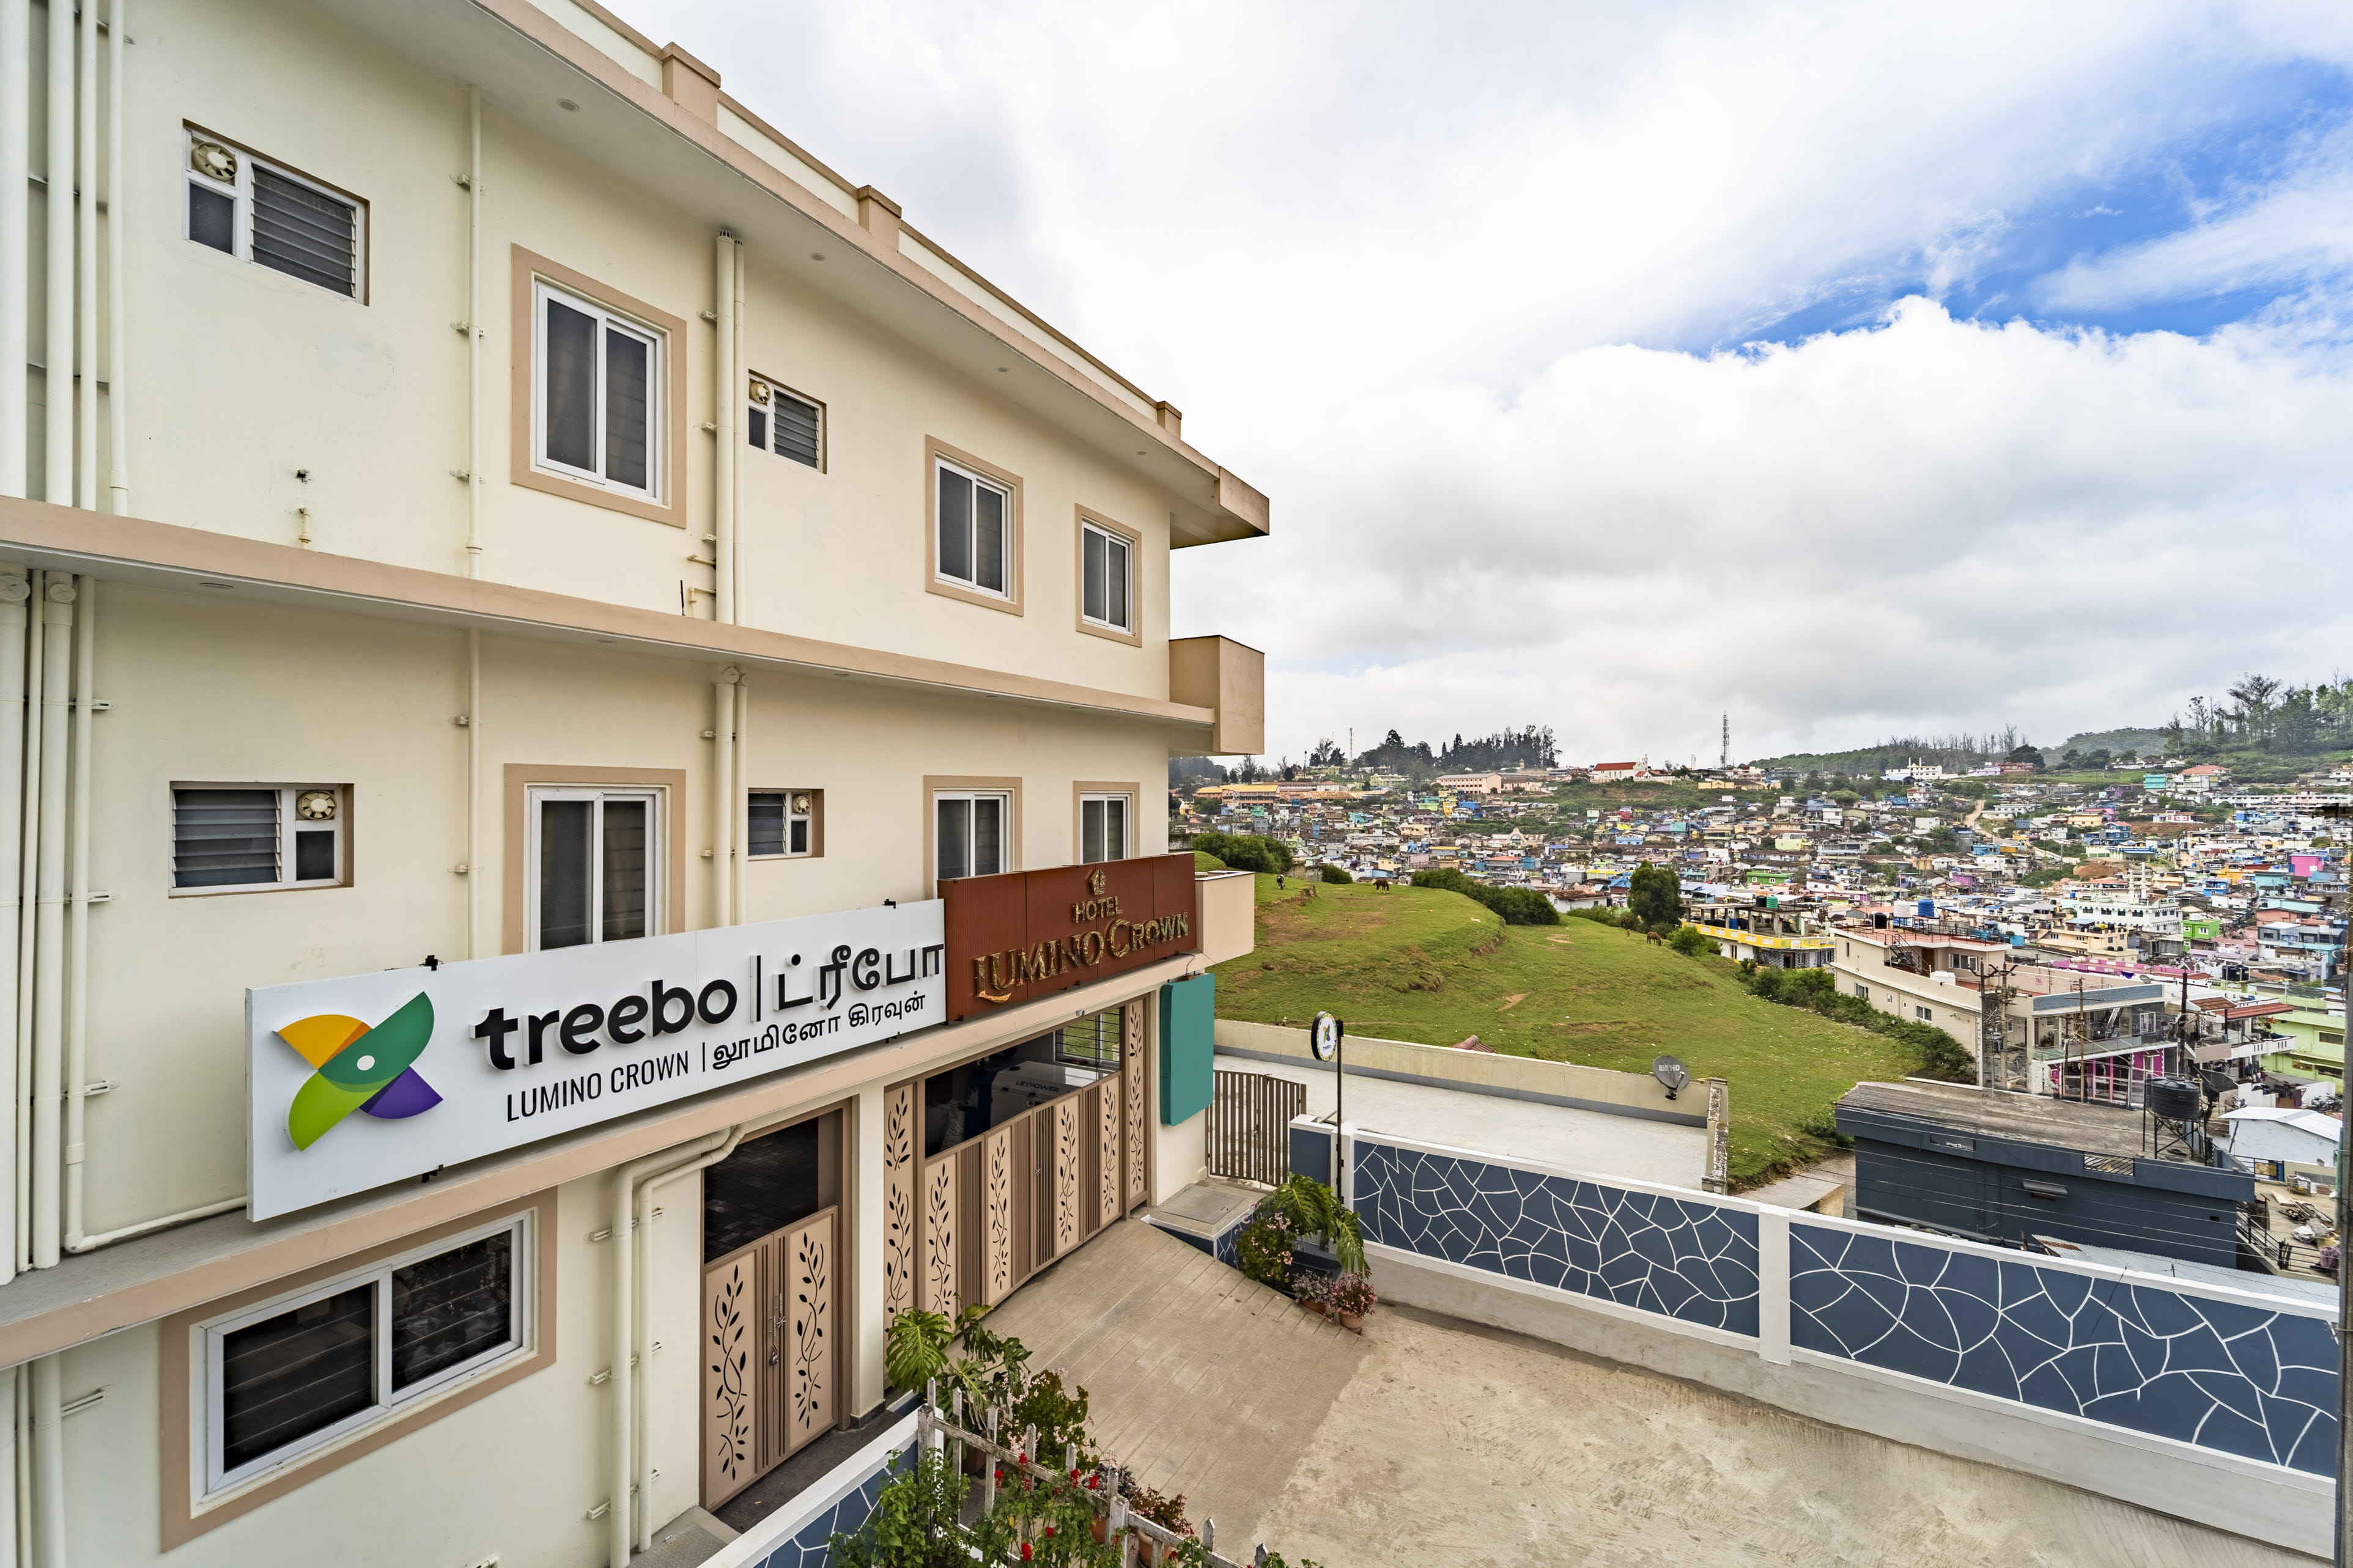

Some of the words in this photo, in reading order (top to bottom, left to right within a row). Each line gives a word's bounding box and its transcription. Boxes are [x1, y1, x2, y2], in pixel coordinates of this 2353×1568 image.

[1074, 896, 1123, 923] HOTEL
[775, 944, 944, 1010] ட்ரீபோ
[975, 930, 1104, 1003] LUMINO
[1109, 911, 1188, 958] CROWN
[473, 979, 737, 1071] treebo
[712, 1015, 841, 1070] லூமினோ
[848, 990, 926, 1029] கிரவுன்
[508, 1073, 602, 1122] LUMINO
[611, 1050, 689, 1093] CROWN
[1015, 1080, 1060, 1093] LEYPOWER
